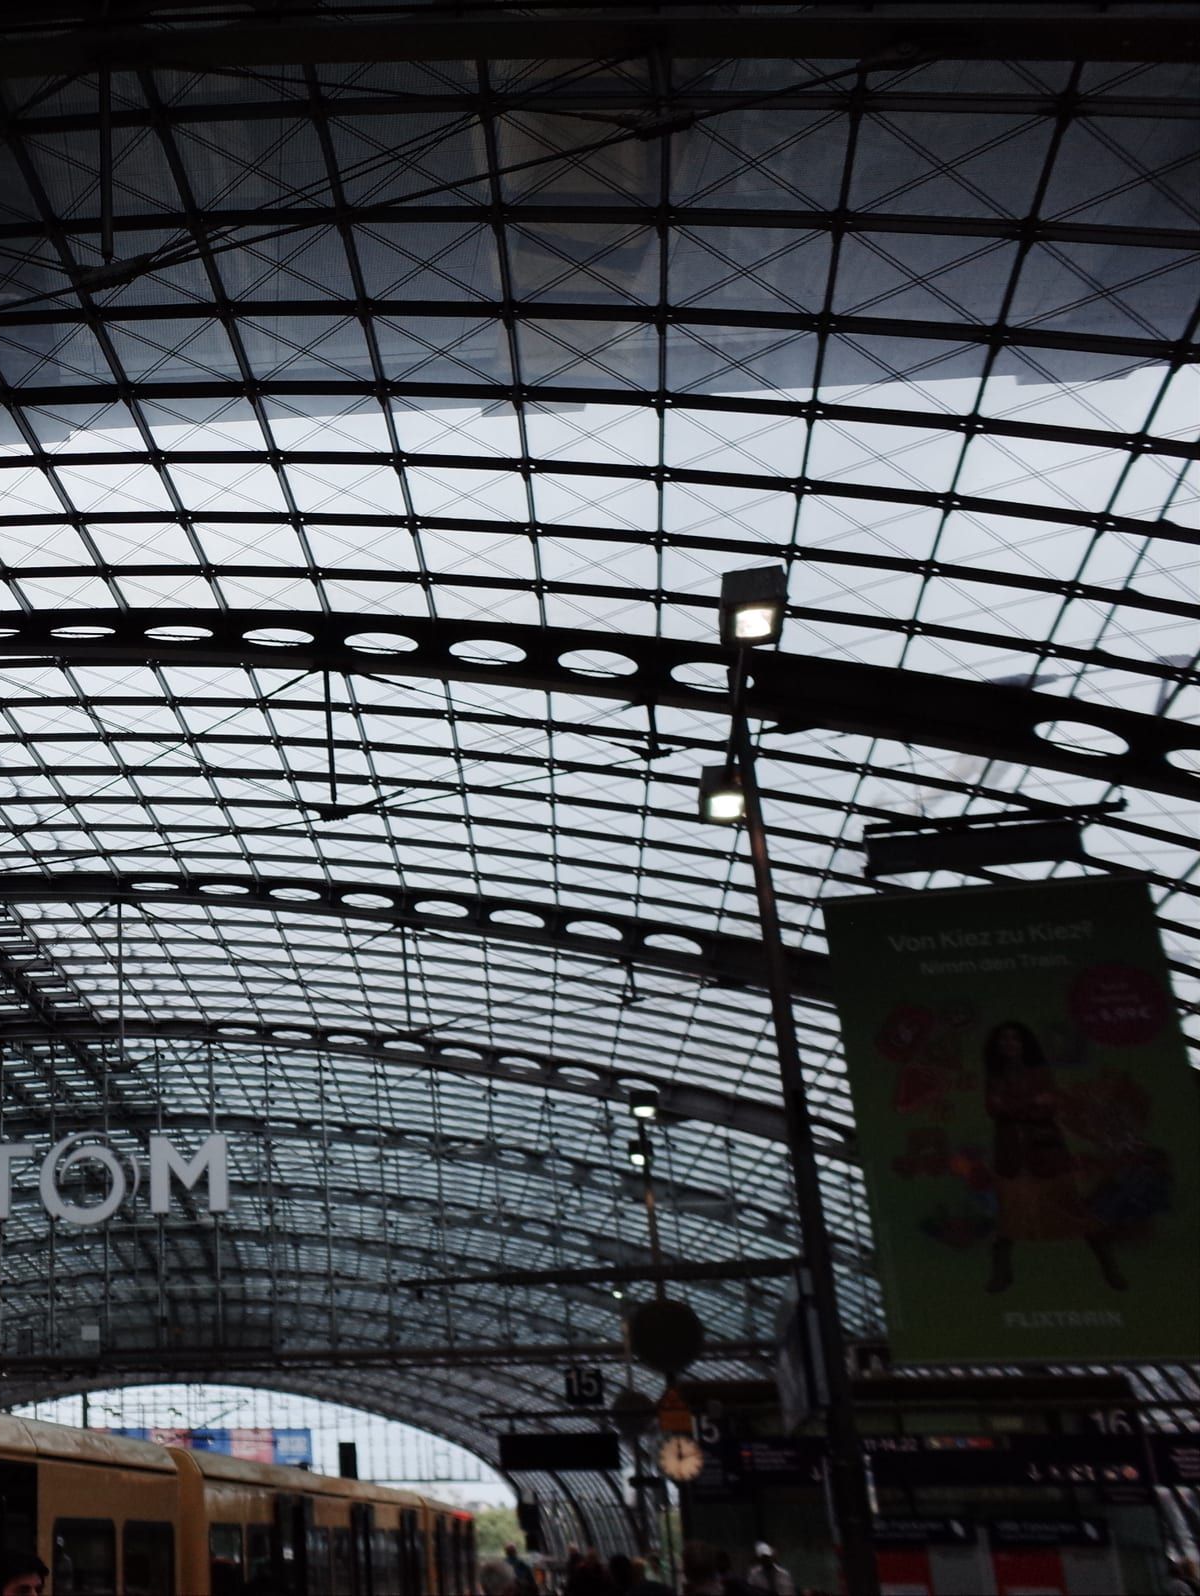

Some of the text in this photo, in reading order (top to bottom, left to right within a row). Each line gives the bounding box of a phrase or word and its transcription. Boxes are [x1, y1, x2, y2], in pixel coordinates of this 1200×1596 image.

[887, 935, 936, 953] Von
[939, 928, 993, 949] Kiez
[993, 928, 1025, 945] zu
[978, 957, 1016, 971] den
[568, 1369, 599, 1398] 15
[690, 1415, 722, 1446] 15
[1088, 1409, 1135, 1435] 16
